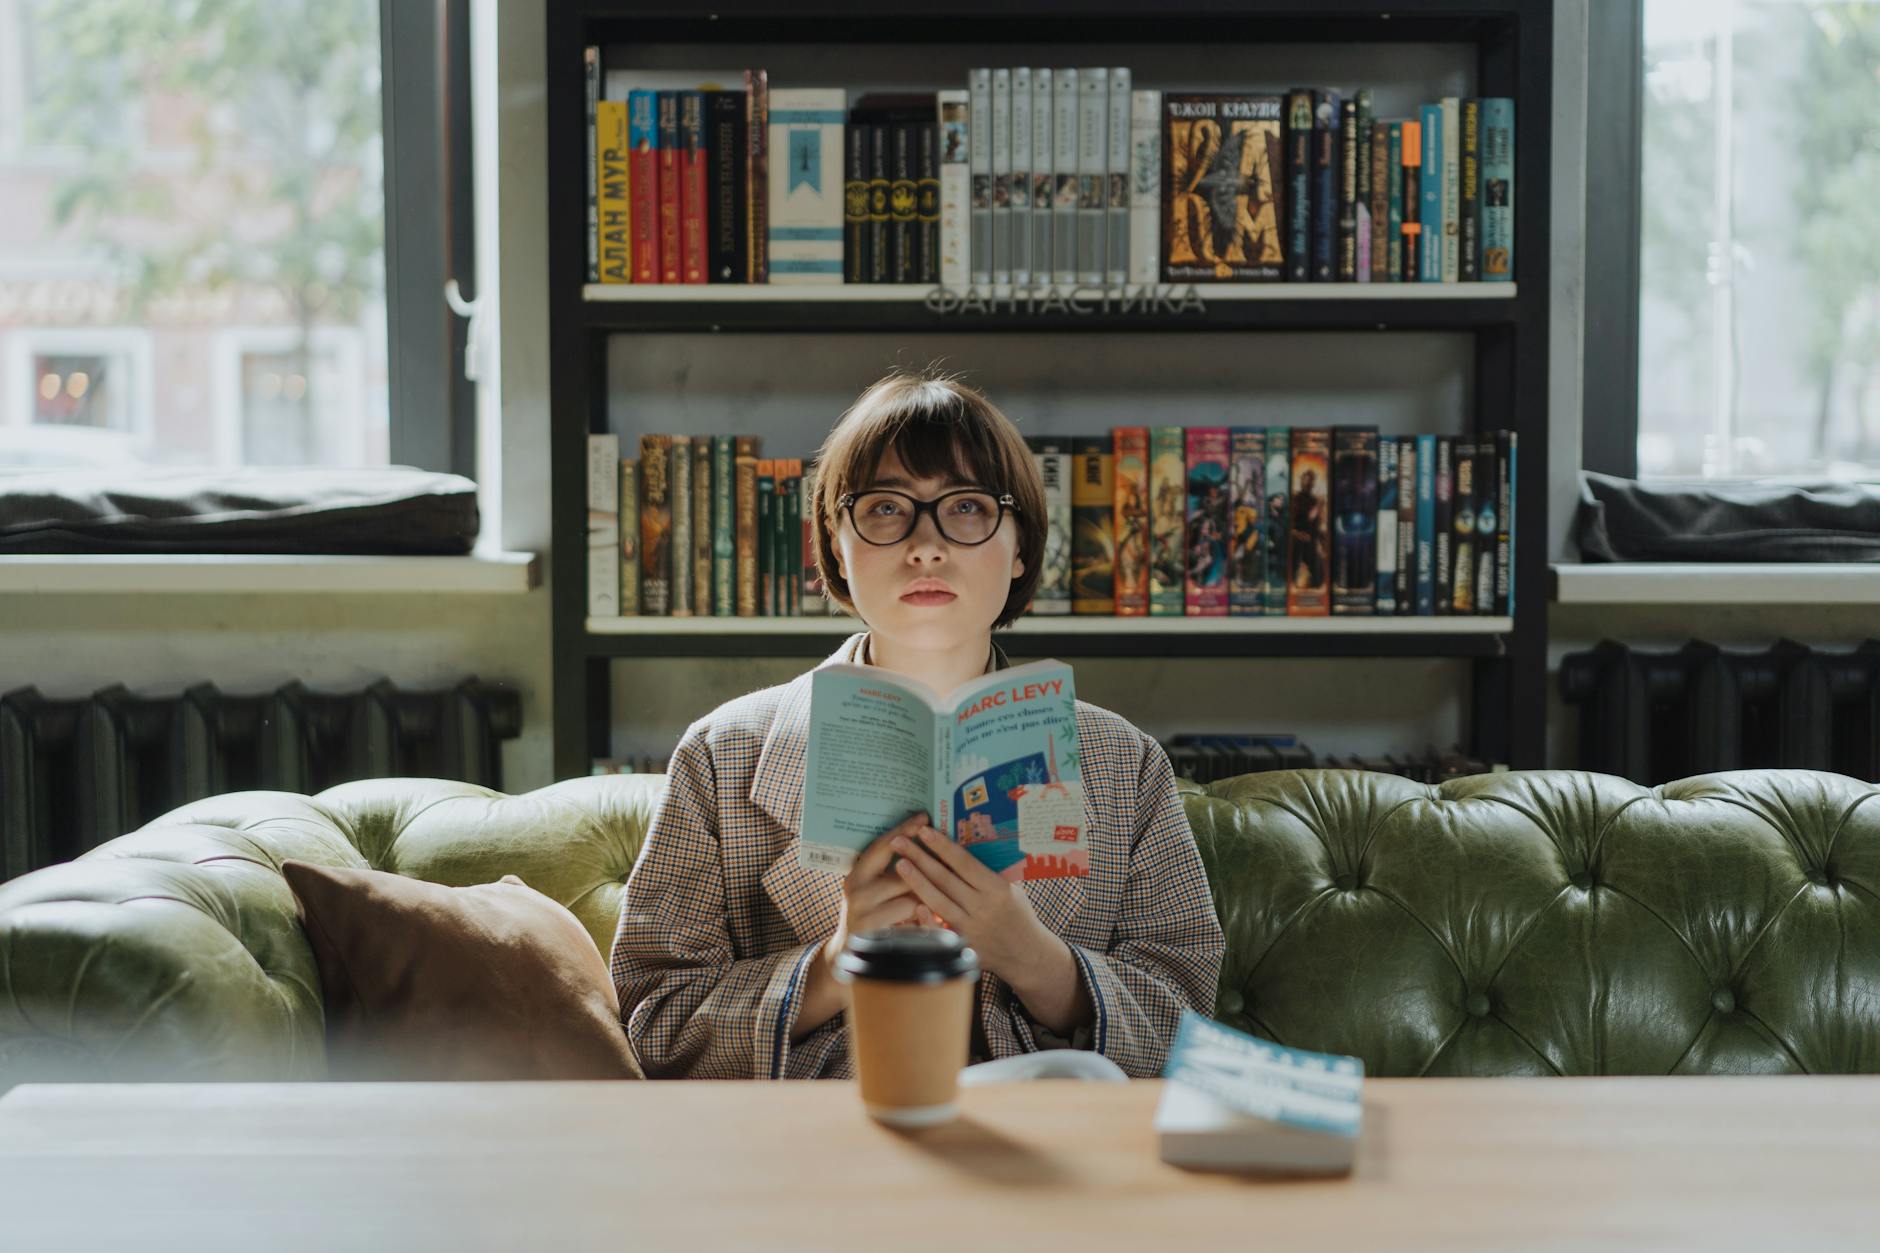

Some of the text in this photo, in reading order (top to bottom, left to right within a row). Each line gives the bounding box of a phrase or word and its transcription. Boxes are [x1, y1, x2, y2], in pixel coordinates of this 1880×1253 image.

[602, 147, 628, 281] АЛАН МУР
[925, 284, 1206, 315] ФАНТАСТИКА
[957, 678, 1064, 727] MARC LEVY
[965, 718, 996, 735] Toutes
[1017, 706, 1055, 718] choses
[1043, 714, 1071, 726] dites
